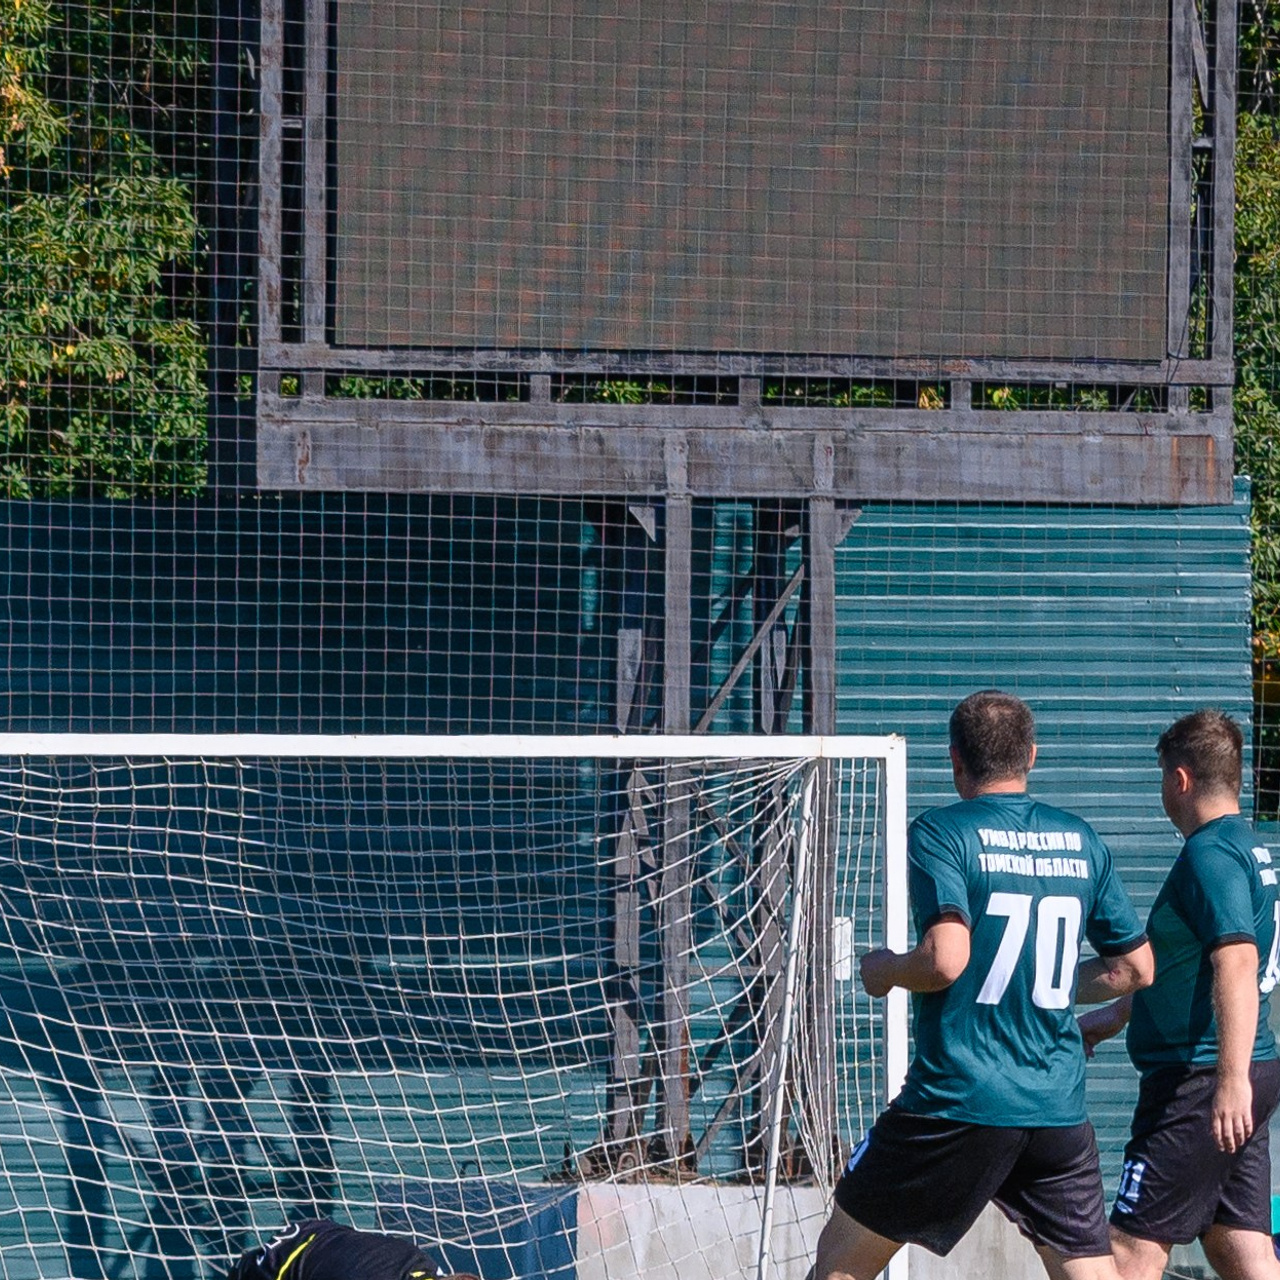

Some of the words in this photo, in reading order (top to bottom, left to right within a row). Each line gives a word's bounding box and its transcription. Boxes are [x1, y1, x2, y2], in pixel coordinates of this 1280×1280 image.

[978, 828, 1019, 851] УМВД
[1017, 831, 1066, 852] РОССИИ
[1064, 832, 1083, 852] ПО
[978, 853, 1035, 877] ТОМСКОЙ
[1035, 858, 1089, 880] ОБЛАСТИ
[976, 891, 1083, 1010] 70
